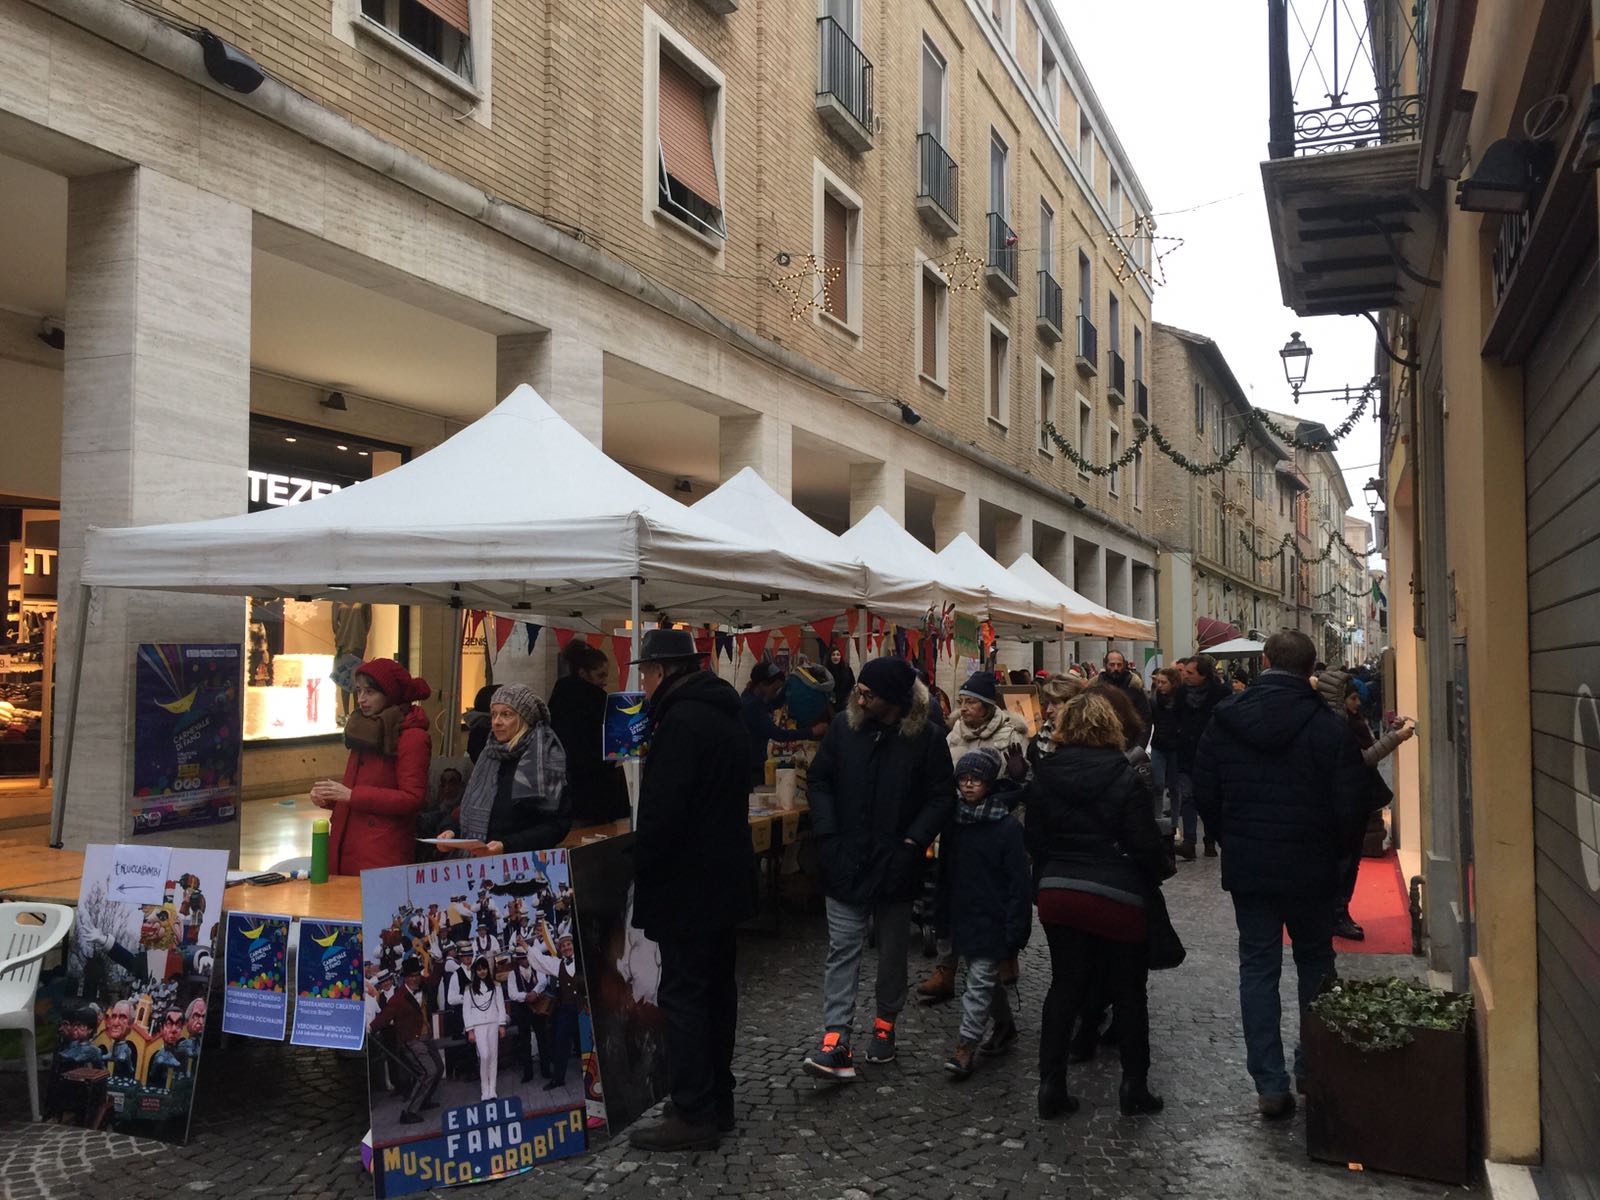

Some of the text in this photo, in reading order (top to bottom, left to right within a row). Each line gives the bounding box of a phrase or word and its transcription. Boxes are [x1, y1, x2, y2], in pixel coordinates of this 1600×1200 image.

[416, 863, 486, 884] MUSICA
[447, 1100, 516, 1130] ENAL
[447, 1122, 523, 1159] FANO
